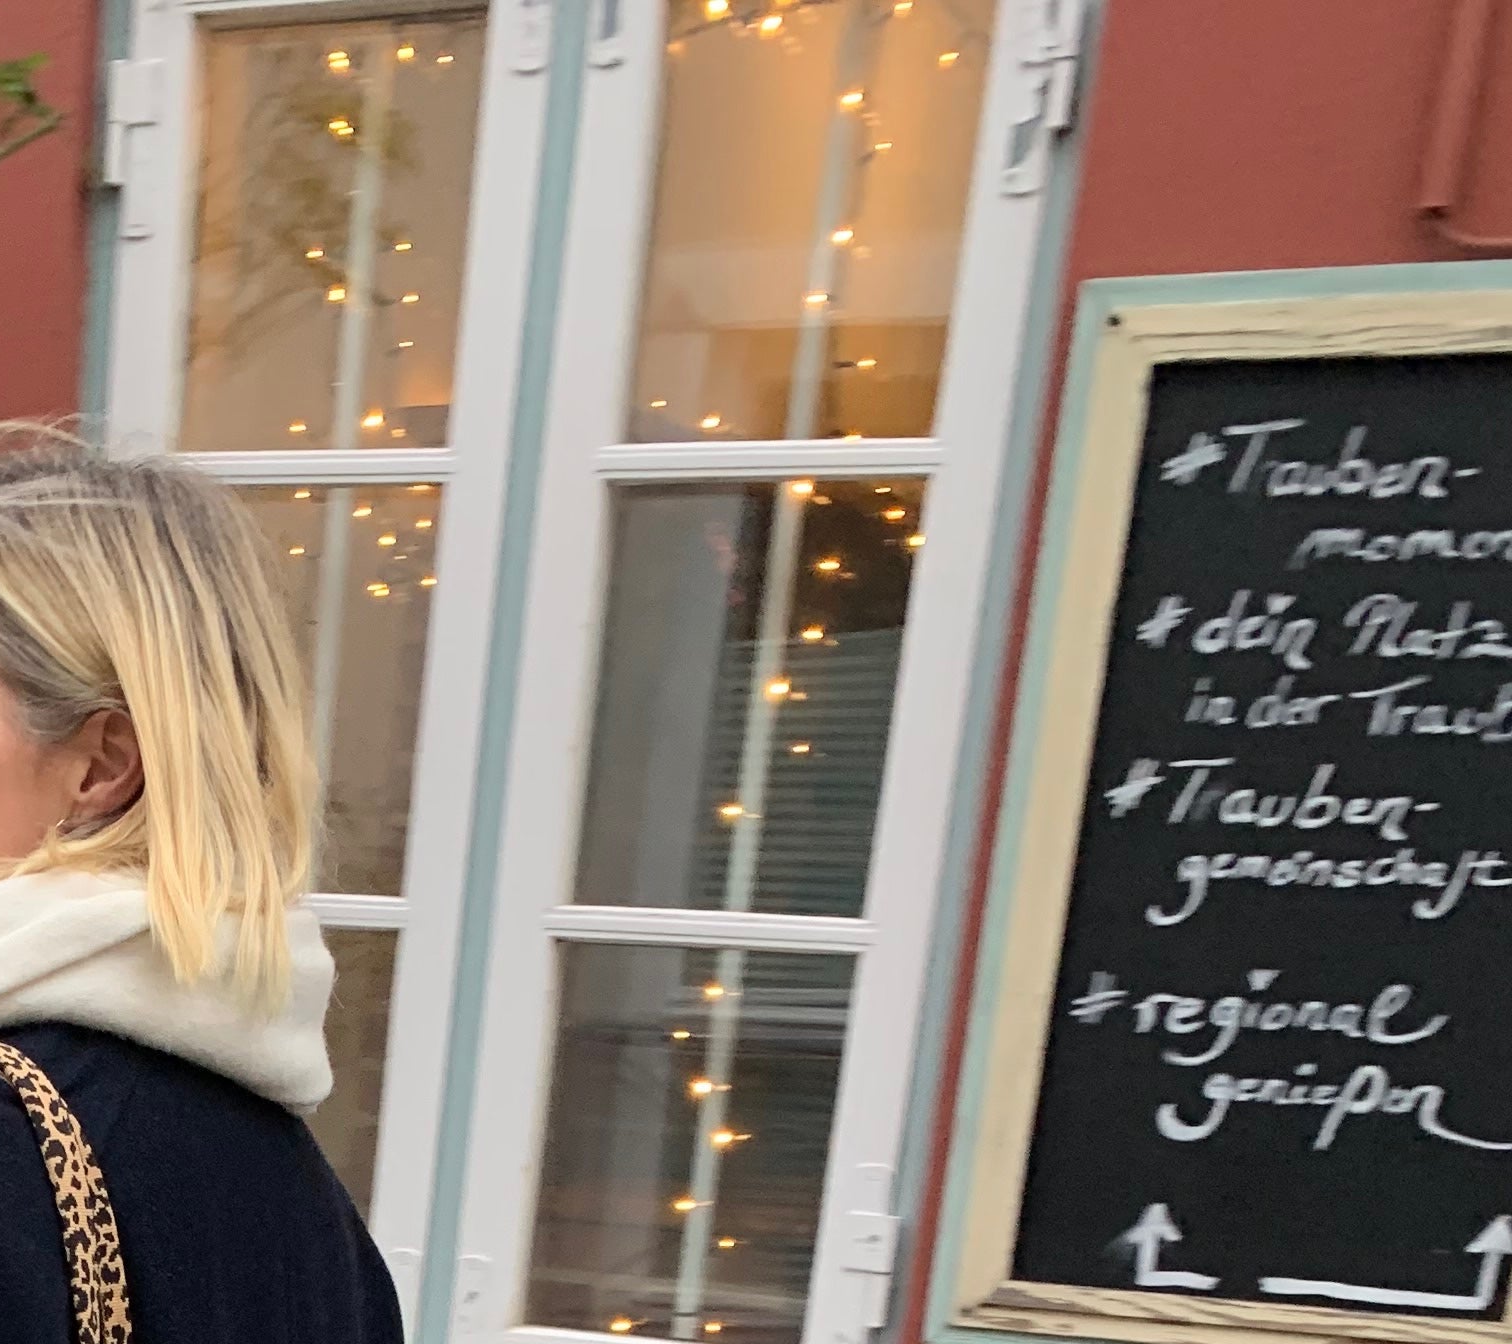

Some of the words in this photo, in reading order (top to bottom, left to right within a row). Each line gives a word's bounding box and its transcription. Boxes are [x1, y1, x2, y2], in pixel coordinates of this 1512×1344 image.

[1184, 676, 1238, 726] in
[1243, 674, 1342, 729] der
[1068, 970, 1452, 1066] #regional
